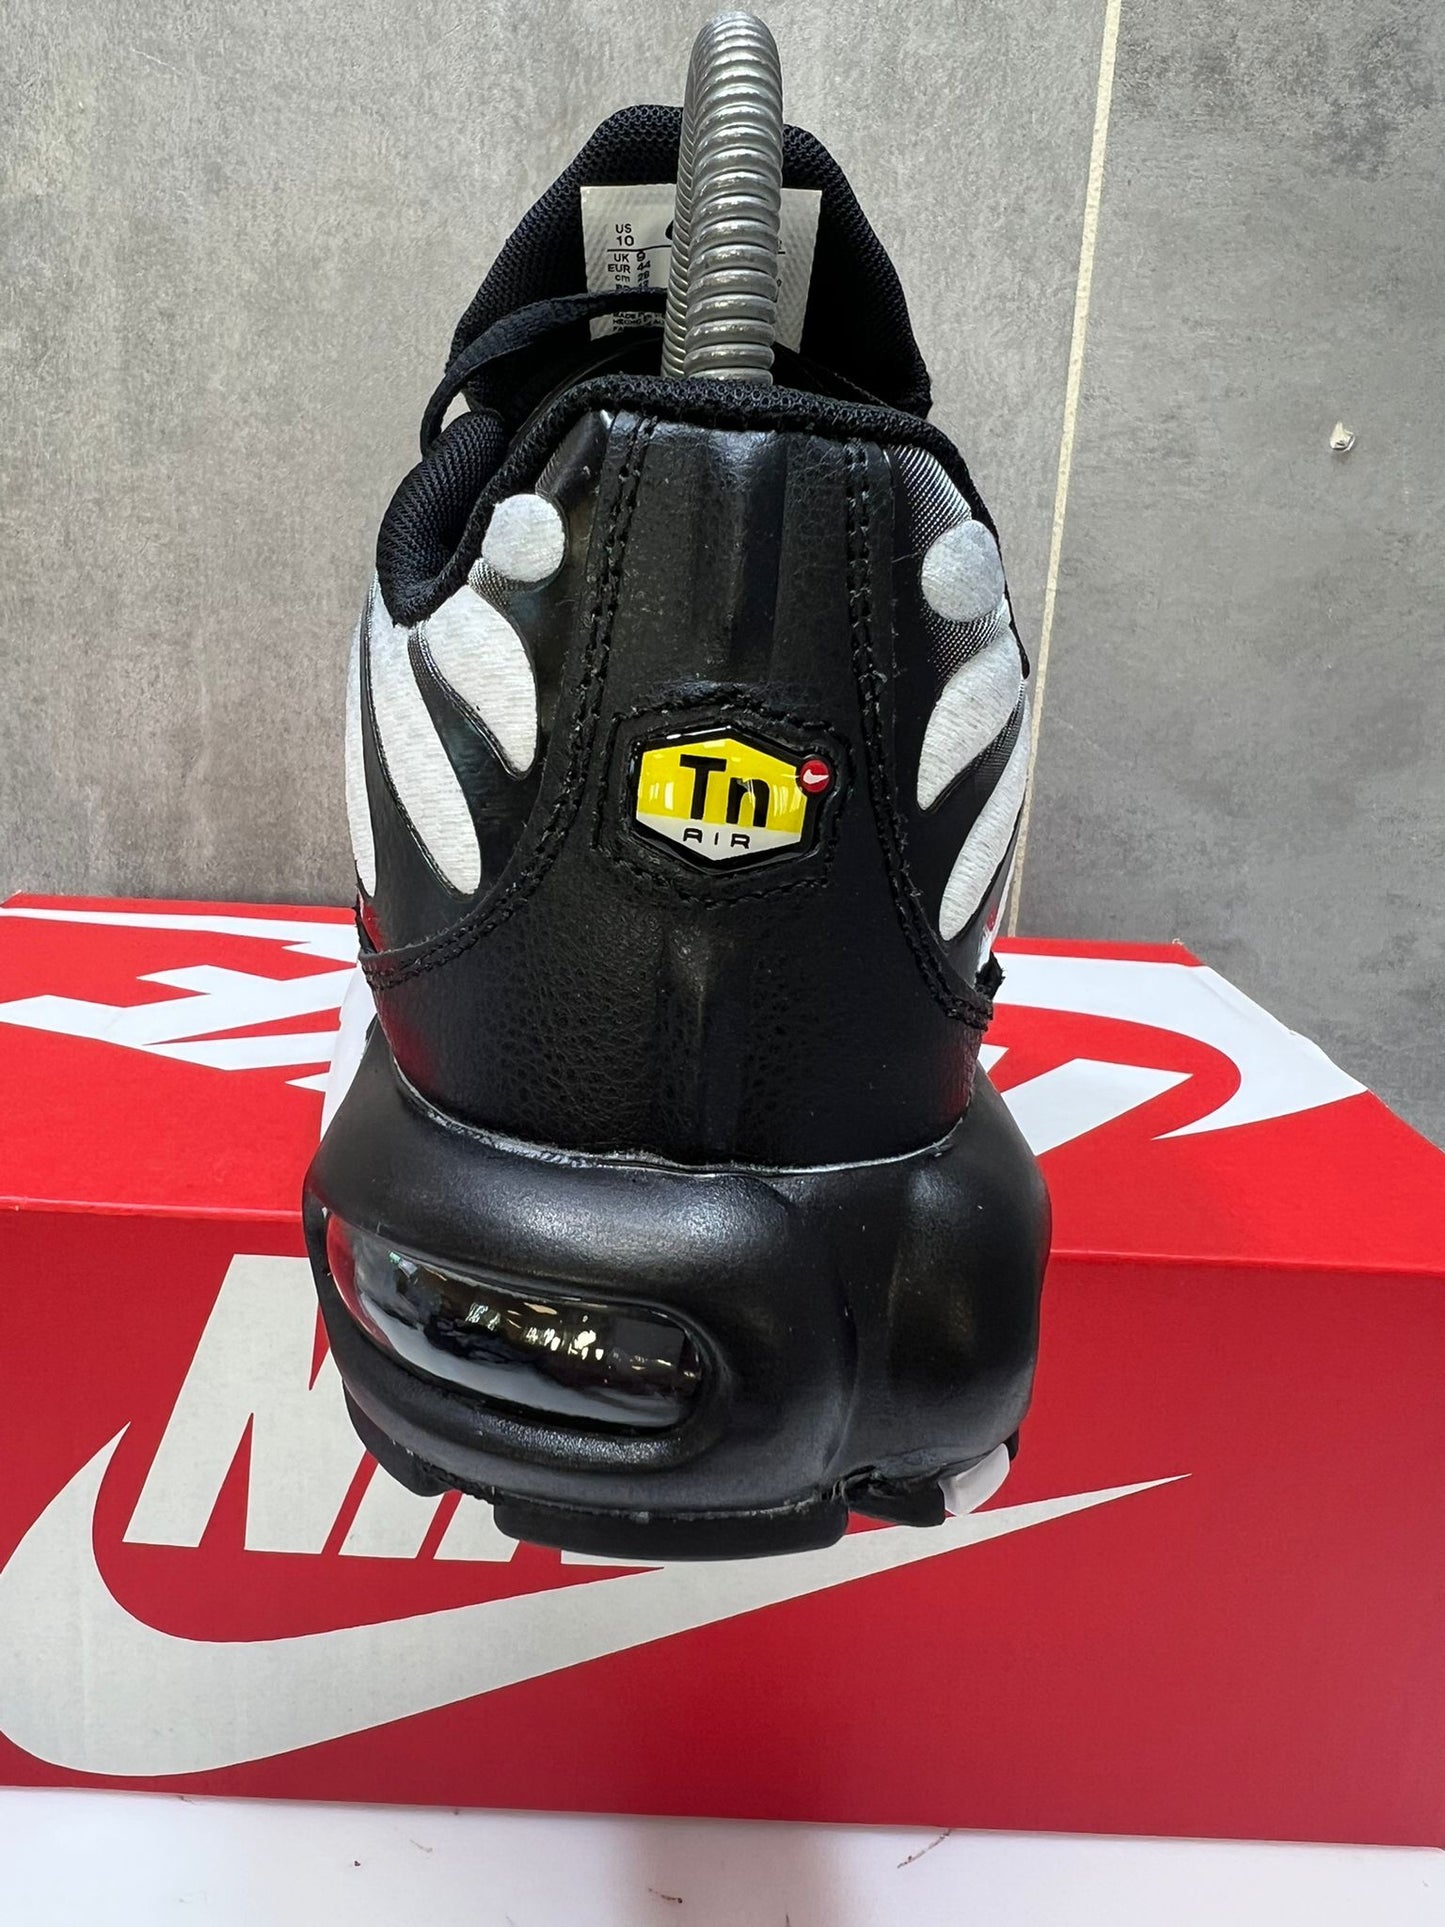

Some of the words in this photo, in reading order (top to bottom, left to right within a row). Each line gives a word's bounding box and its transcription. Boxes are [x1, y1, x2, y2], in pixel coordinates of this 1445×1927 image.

[615, 223, 632, 234] US
[616, 235, 634, 247] 10
[614, 253, 630, 263] UK
[636, 251, 646, 262] 9
[607, 263, 631, 274] EUR
[637, 260, 651, 271] 44
[615, 274, 631, 282] cm
[679, 754, 771, 828] Tn
[682, 827, 751, 849] AIR
